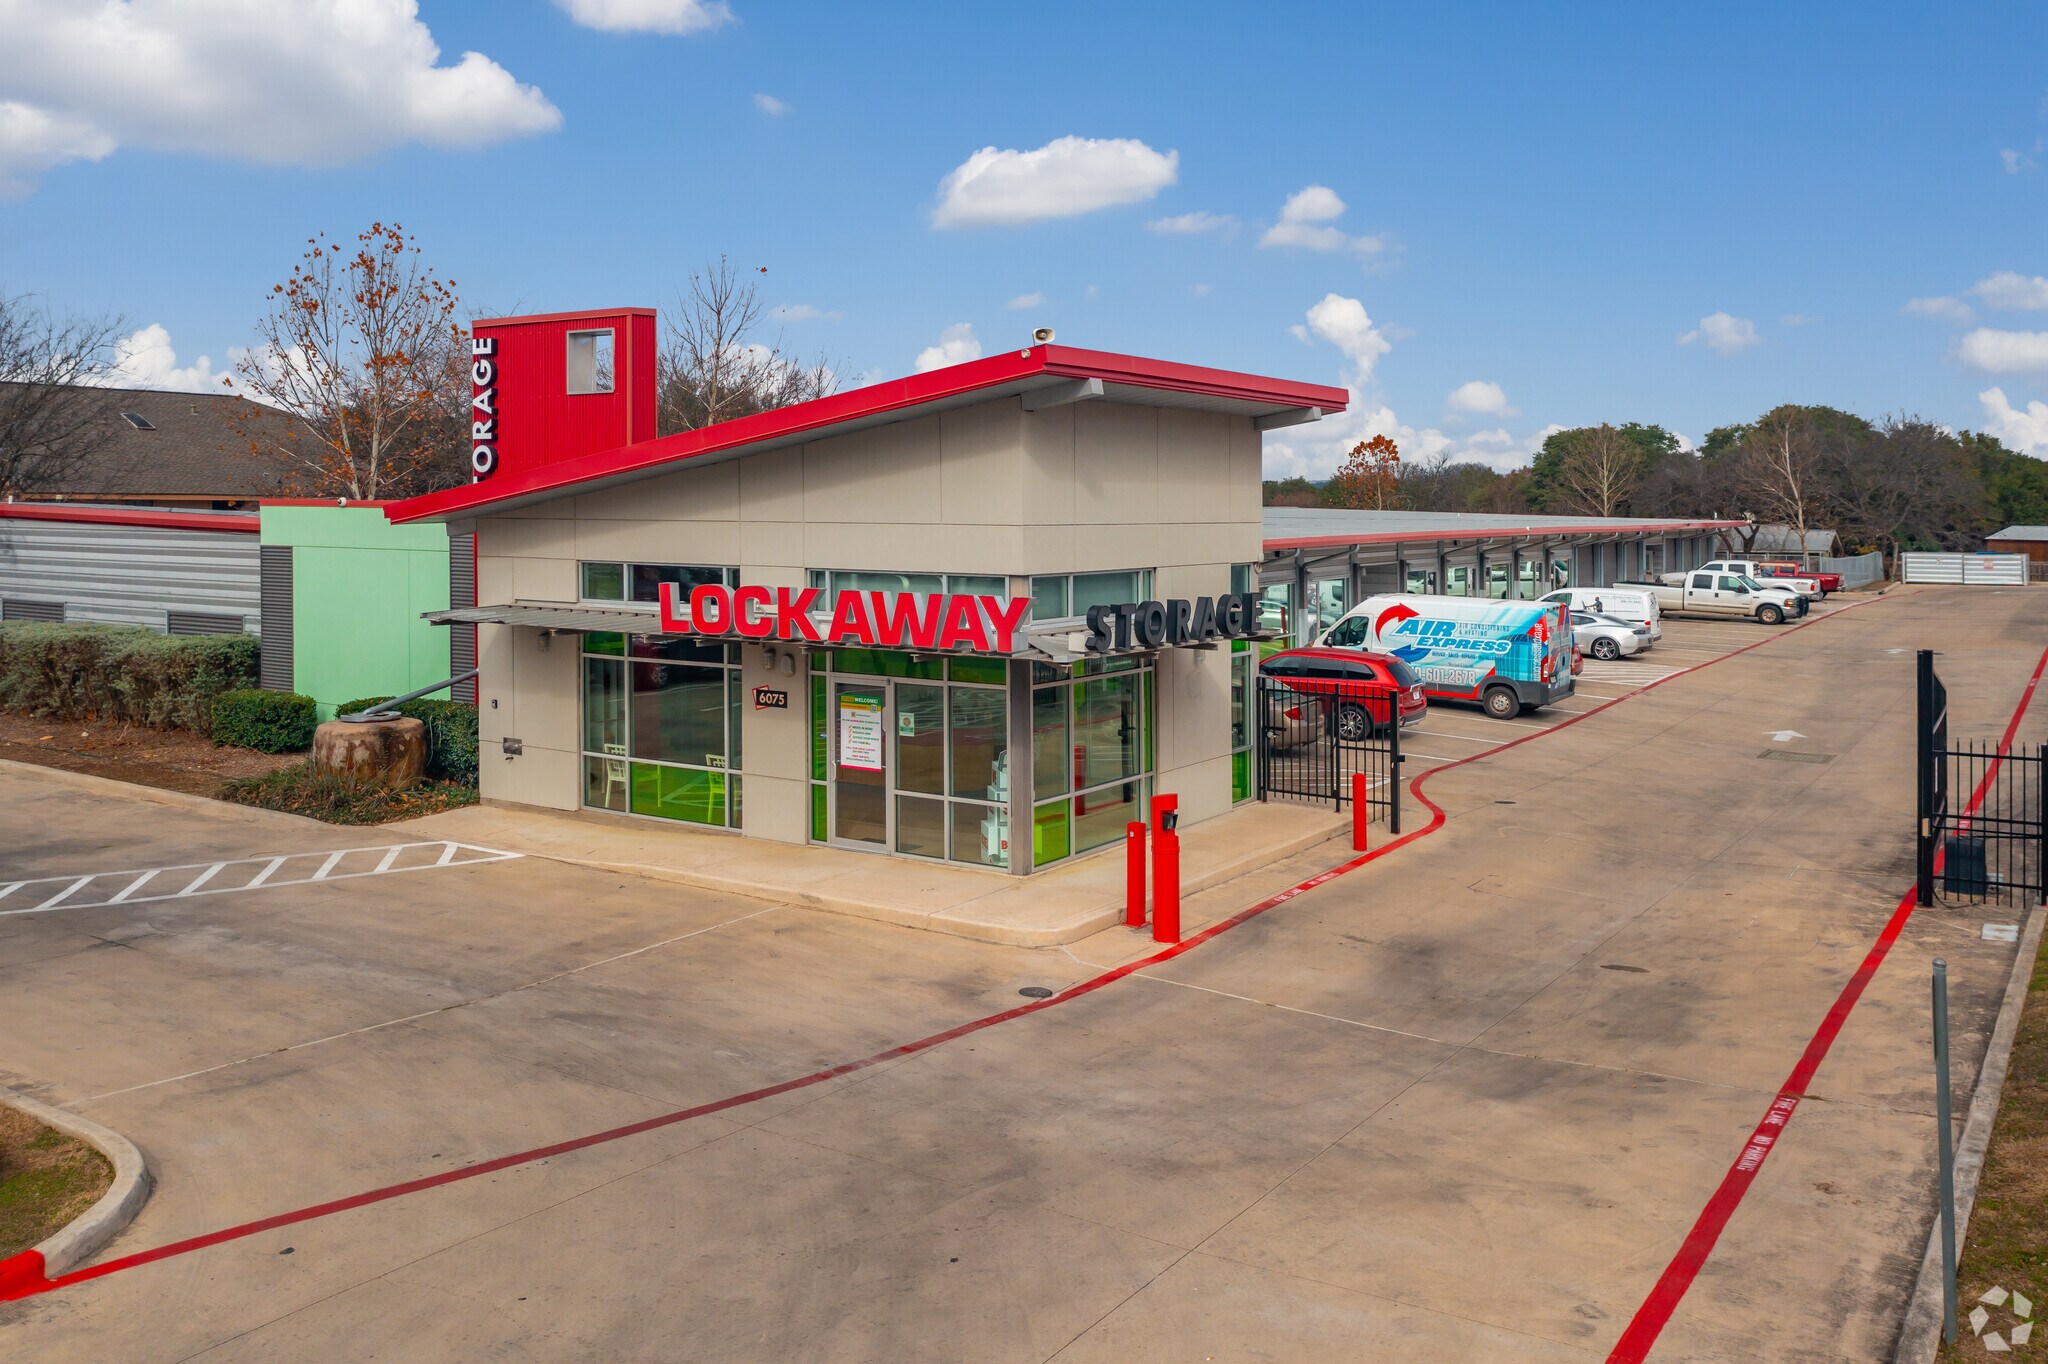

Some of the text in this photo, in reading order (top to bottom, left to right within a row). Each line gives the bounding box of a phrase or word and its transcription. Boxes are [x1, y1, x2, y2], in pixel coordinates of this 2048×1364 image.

[472, 337, 497, 484] ORAGE
[1085, 592, 1265, 653] STORAGE
[1393, 618, 1457, 638] AIR
[1414, 636, 1511, 654] EXPRESS
[759, 692, 785, 705] 6075
